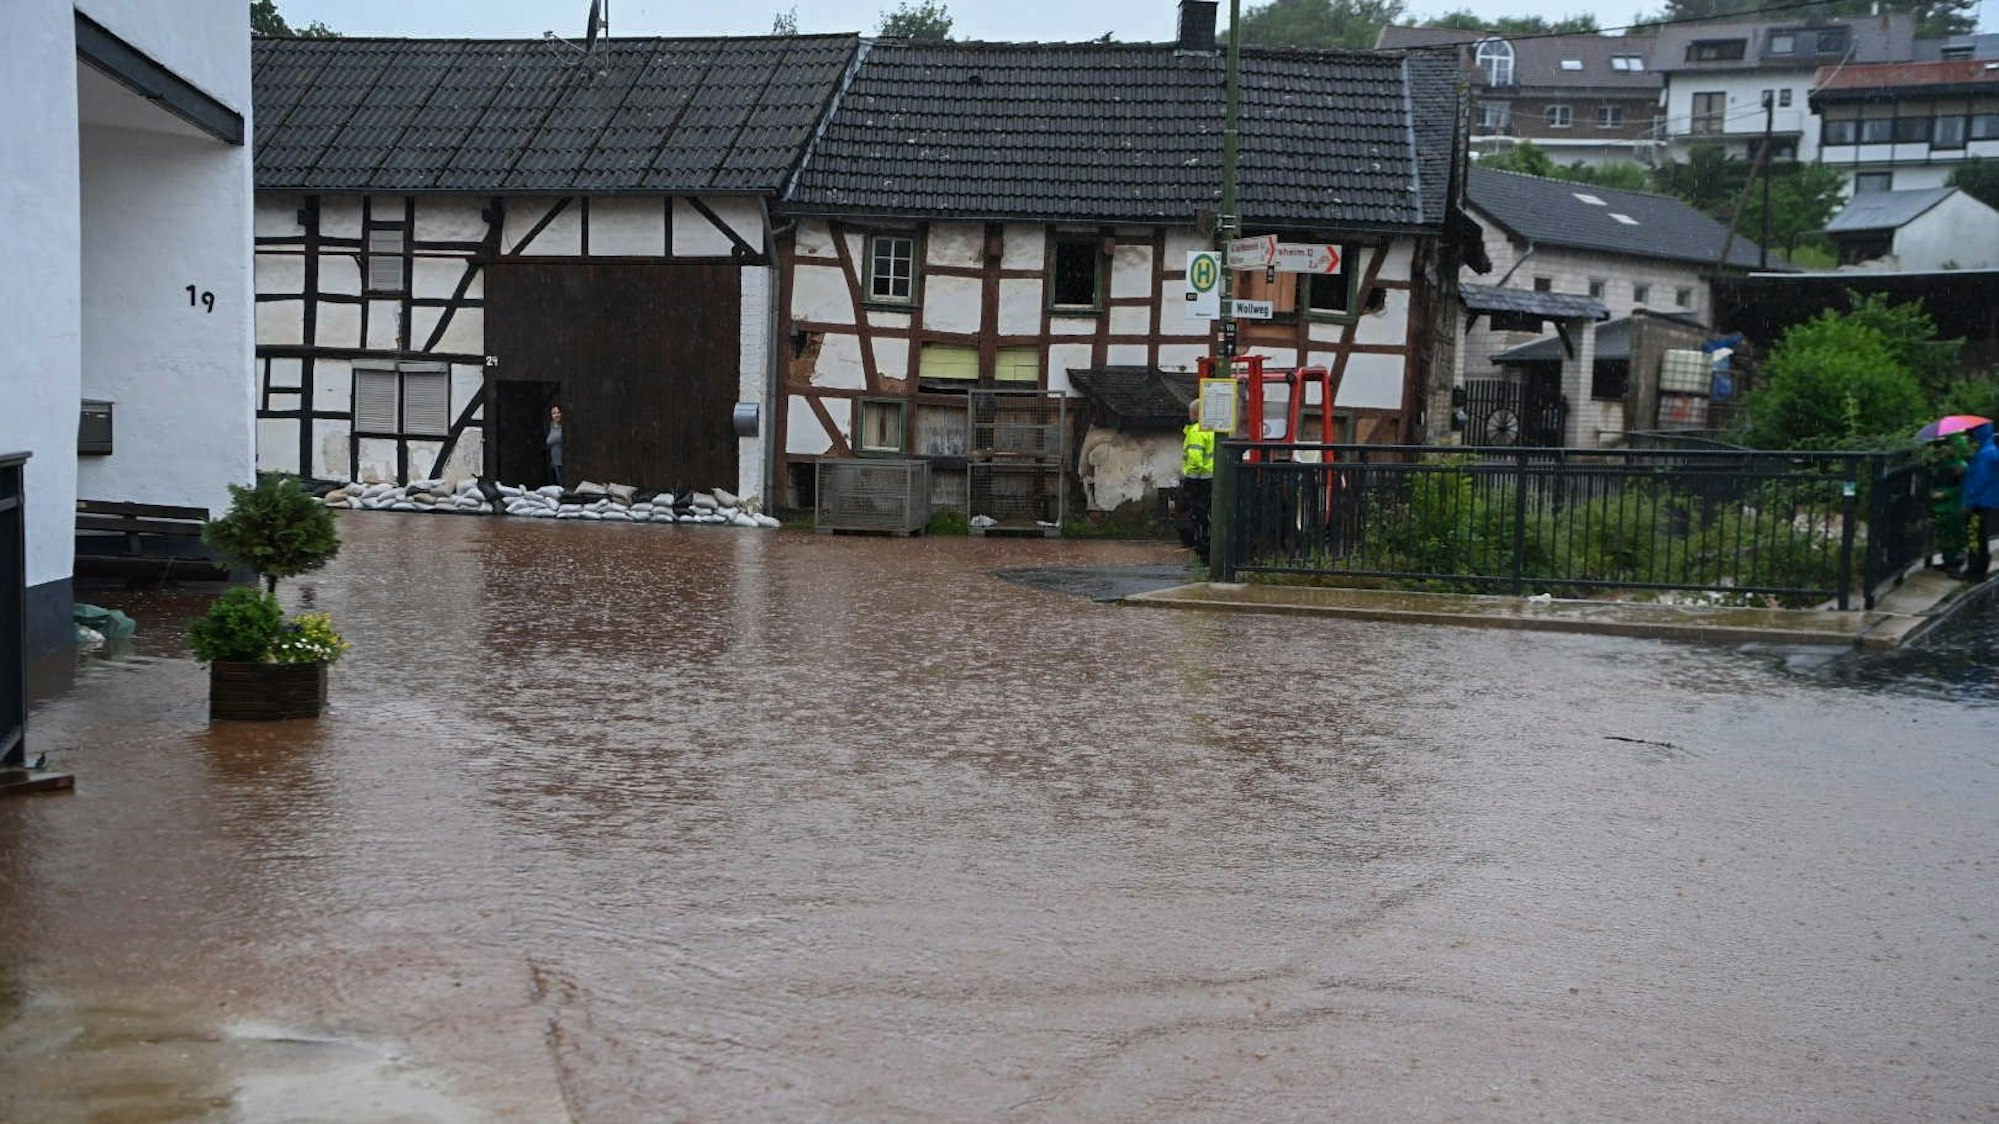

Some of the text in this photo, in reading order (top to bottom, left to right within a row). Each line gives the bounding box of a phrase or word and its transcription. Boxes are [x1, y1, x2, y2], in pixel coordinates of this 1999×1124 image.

[1279, 247, 1305, 256] sheim
[1198, 262, 1210, 283] H
[185, 284, 215, 313] 19
[1236, 302, 1269, 317] Wollweg
